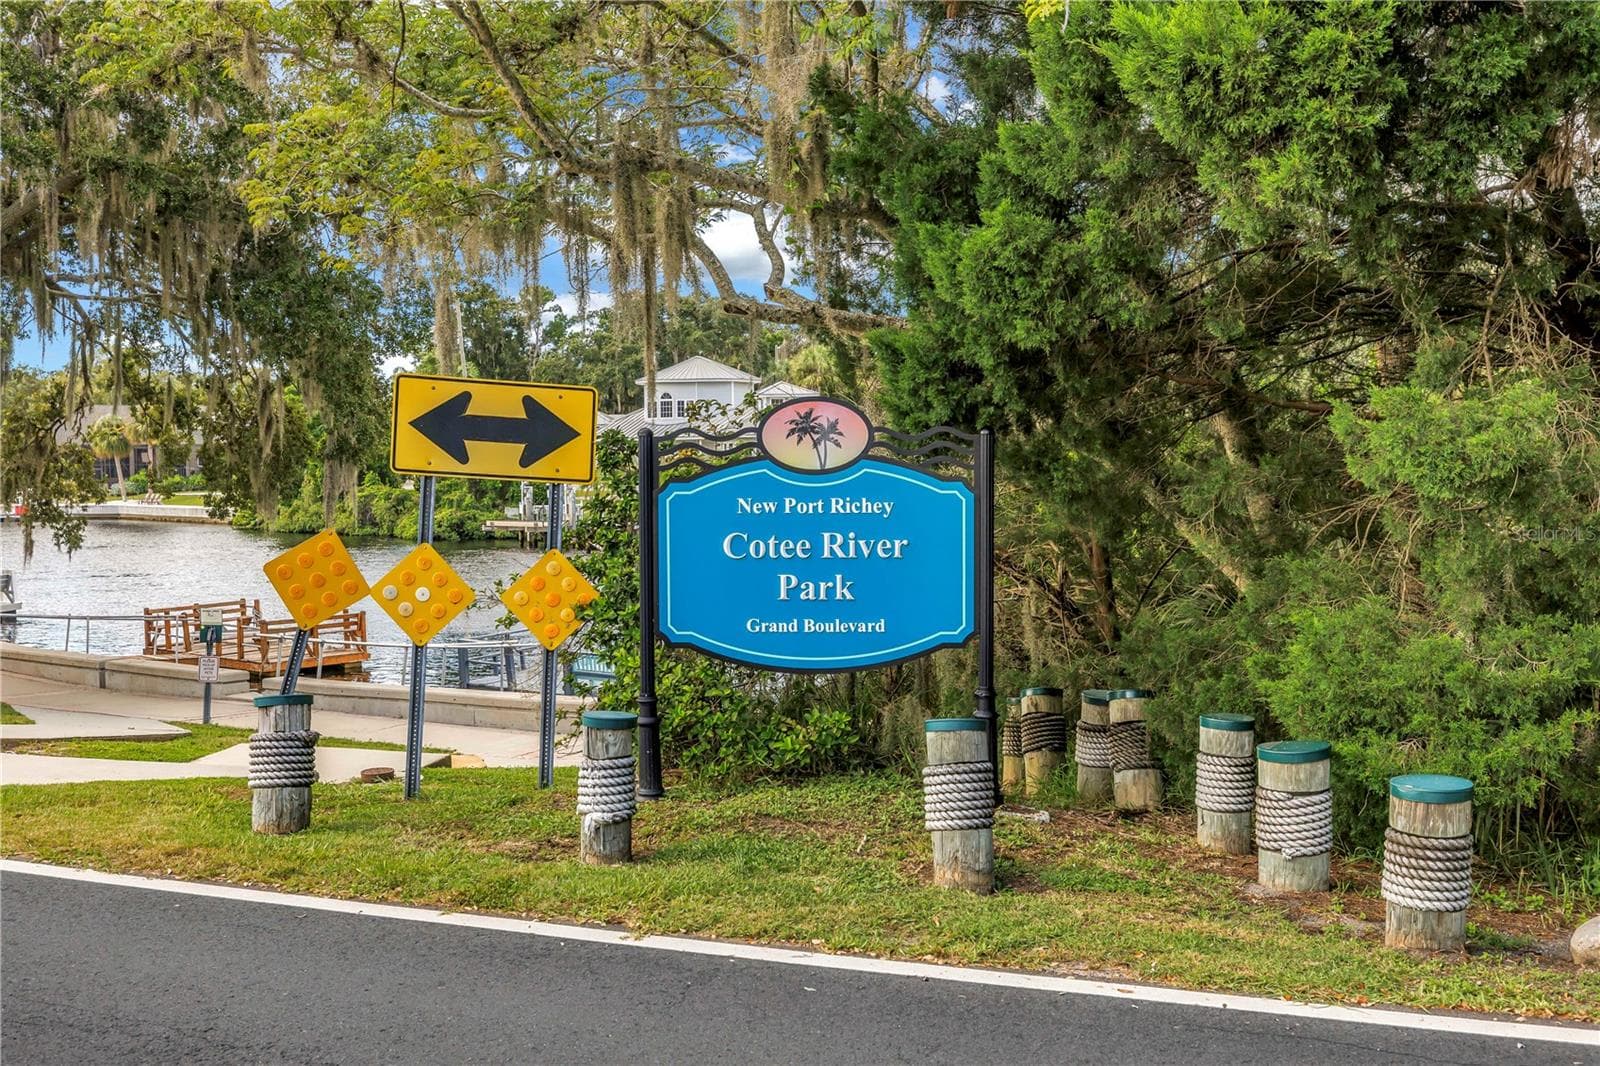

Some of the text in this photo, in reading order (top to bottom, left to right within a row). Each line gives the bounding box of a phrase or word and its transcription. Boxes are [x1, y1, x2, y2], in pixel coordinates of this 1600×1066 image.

[737, 497, 894, 519] New Port Richey
[722, 532, 910, 560] Cotee River
[777, 573, 855, 602] Park
[746, 618, 886, 634] Grand Boulevard
